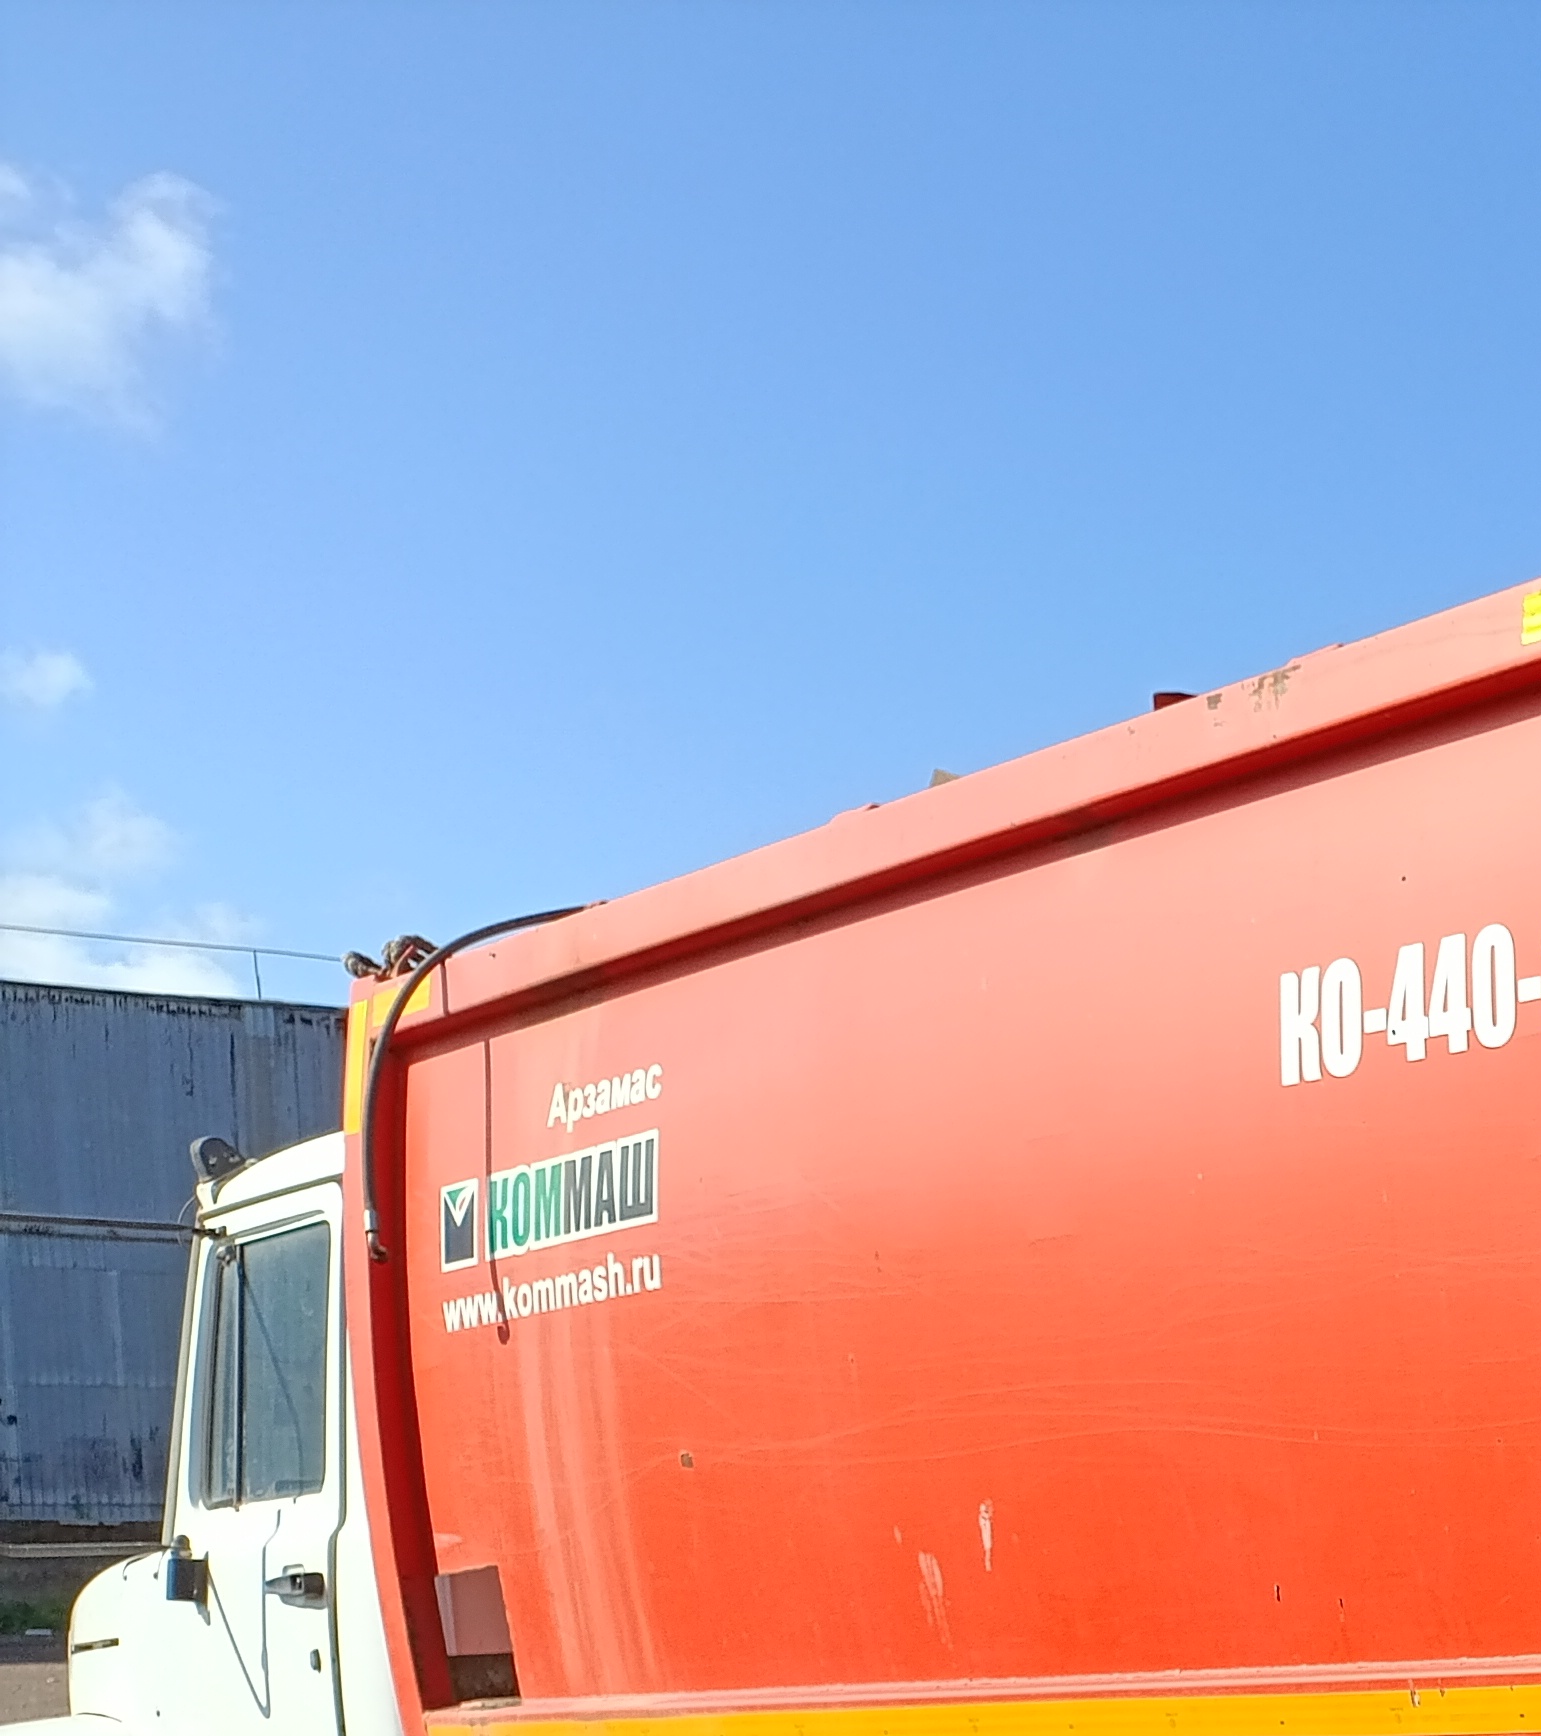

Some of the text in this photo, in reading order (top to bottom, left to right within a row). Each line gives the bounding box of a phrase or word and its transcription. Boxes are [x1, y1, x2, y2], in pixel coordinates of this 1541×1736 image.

[546, 1063, 663, 1133] Арзамас
[489, 1136, 656, 1256] КОММАШ
[442, 1252, 663, 1333] www.kommash.ru
